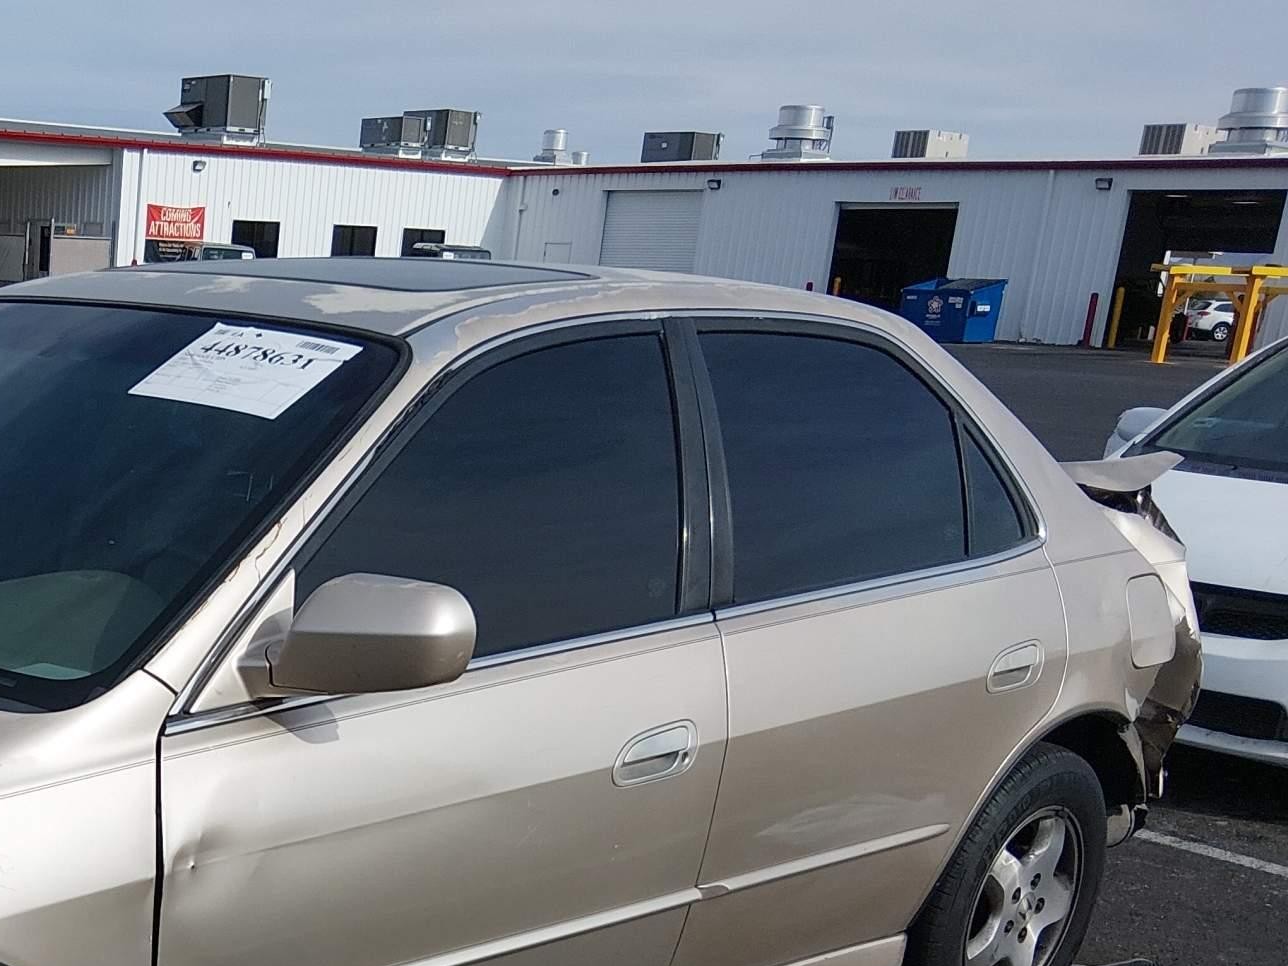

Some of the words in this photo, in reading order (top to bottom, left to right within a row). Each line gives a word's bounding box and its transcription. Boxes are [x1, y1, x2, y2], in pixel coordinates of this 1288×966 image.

[160, 207, 193, 223] COMING
[148, 220, 202, 238] ATTRACTIONS
[200, 340, 316, 370] 44878631
